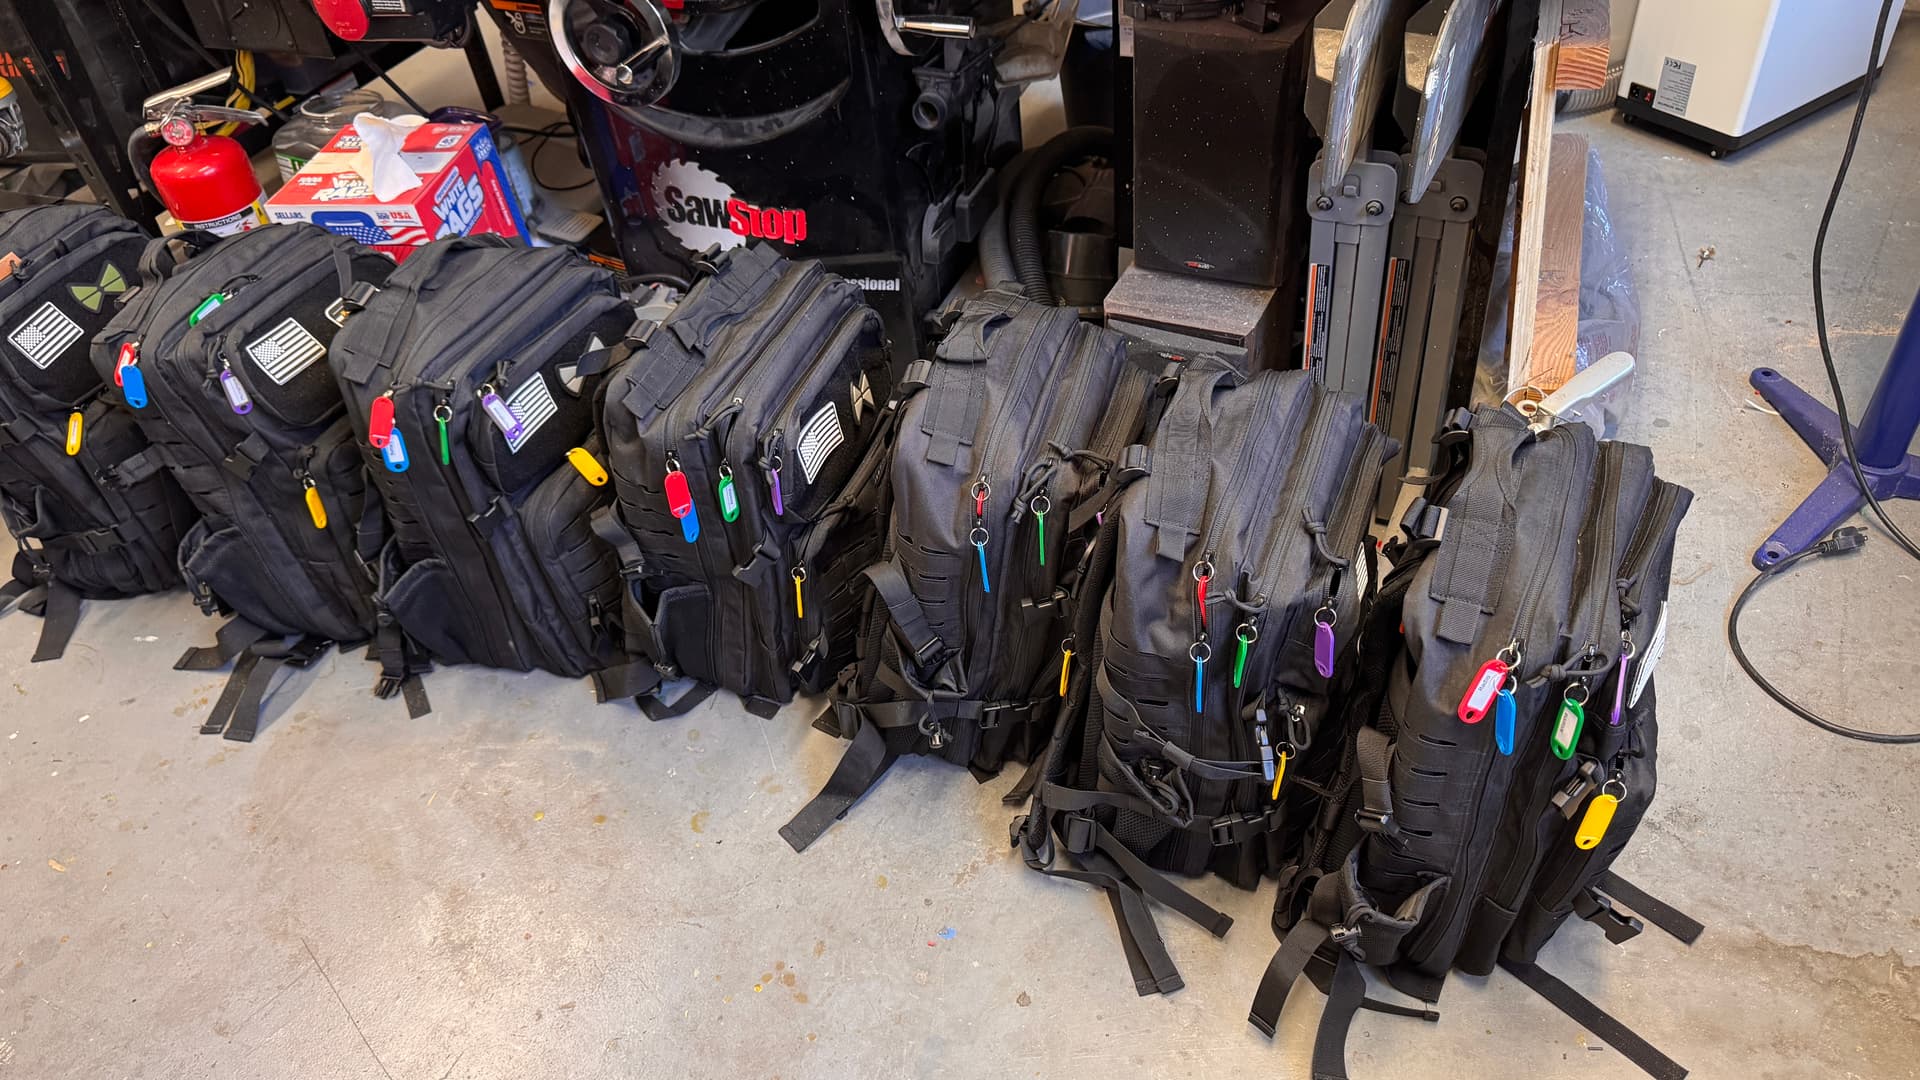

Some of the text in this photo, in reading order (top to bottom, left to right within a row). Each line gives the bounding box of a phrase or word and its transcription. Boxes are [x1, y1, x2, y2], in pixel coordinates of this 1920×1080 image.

[432, 175, 466, 221] WHITE
[193, 213, 242, 229] INSTRUCTIONS
[274, 211, 304, 219] SELLARS
[390, 211, 412, 219] USA
[663, 186, 808, 244] SawStop
[843, 277, 900, 291] ssional
